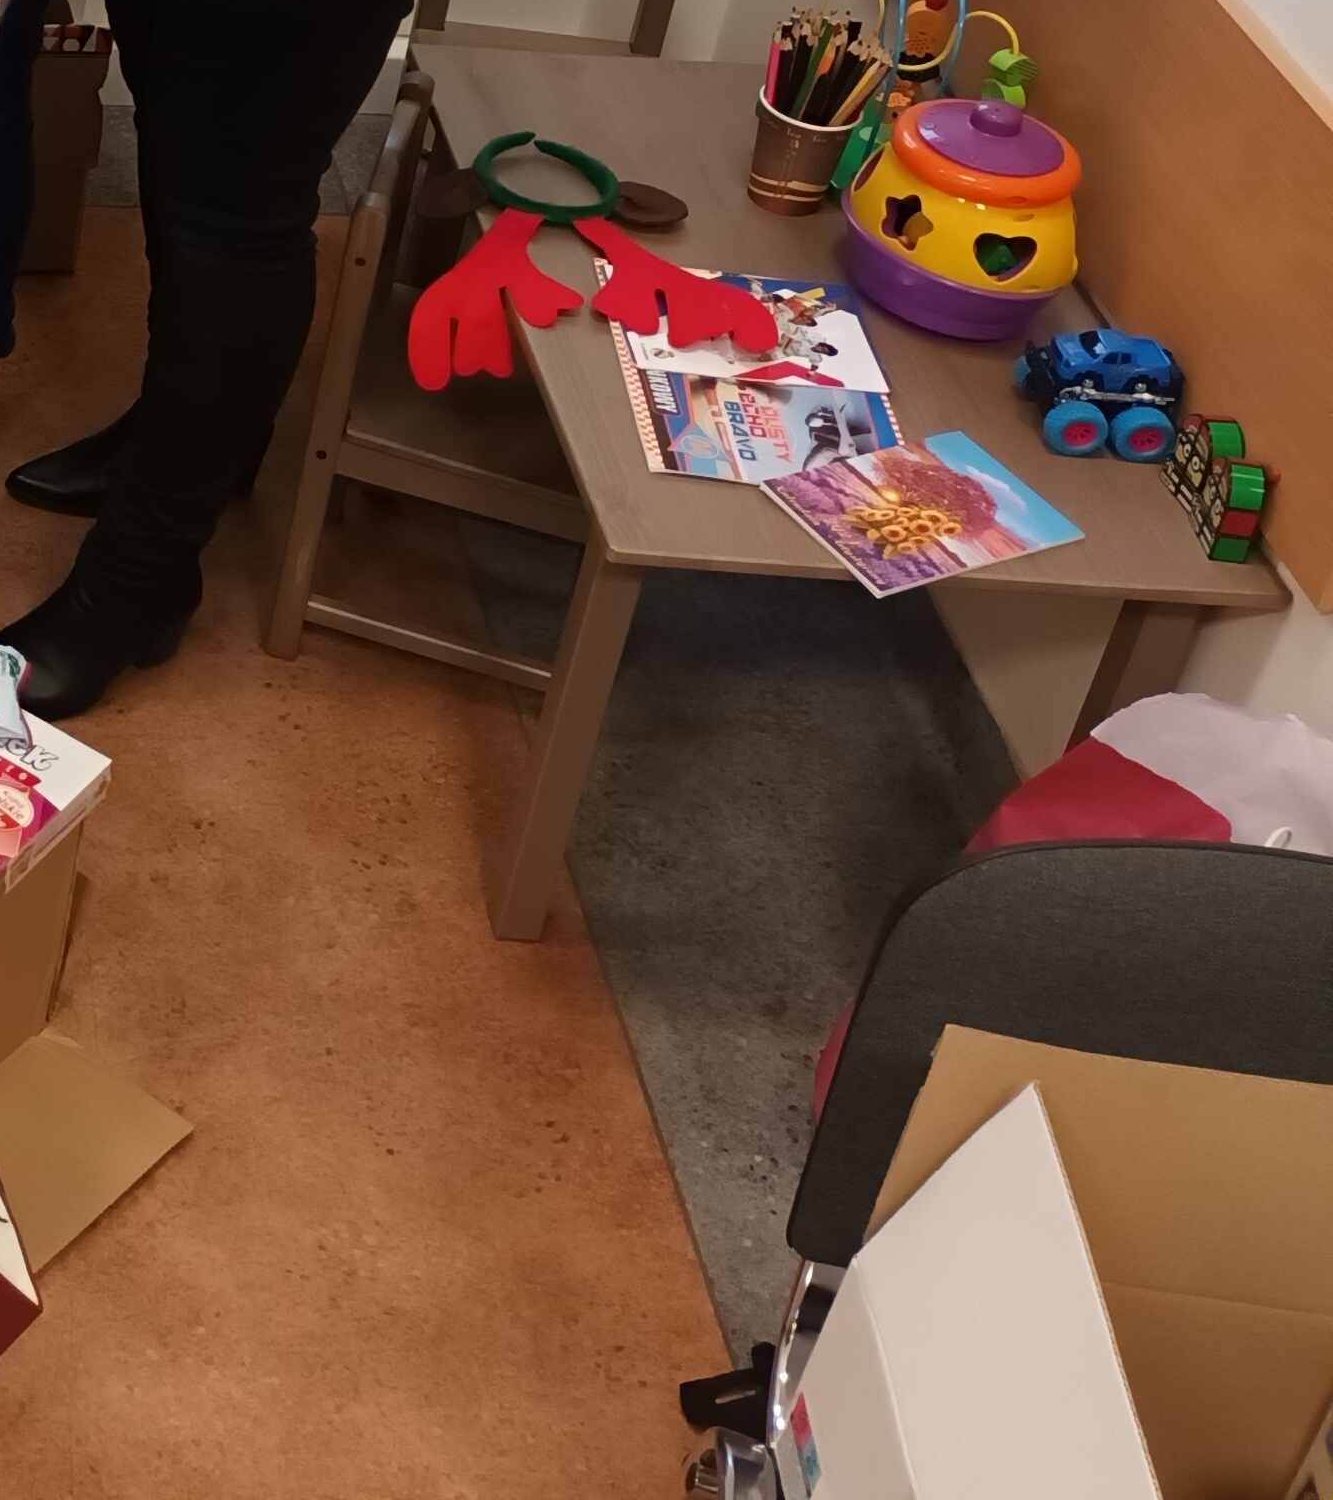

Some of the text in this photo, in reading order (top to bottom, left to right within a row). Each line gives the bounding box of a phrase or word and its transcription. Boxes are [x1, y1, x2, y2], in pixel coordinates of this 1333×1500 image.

[724, 401, 757, 462] BRAVO
[739, 392, 767, 438] ECHO
[760, 403, 793, 464] DUSTY
